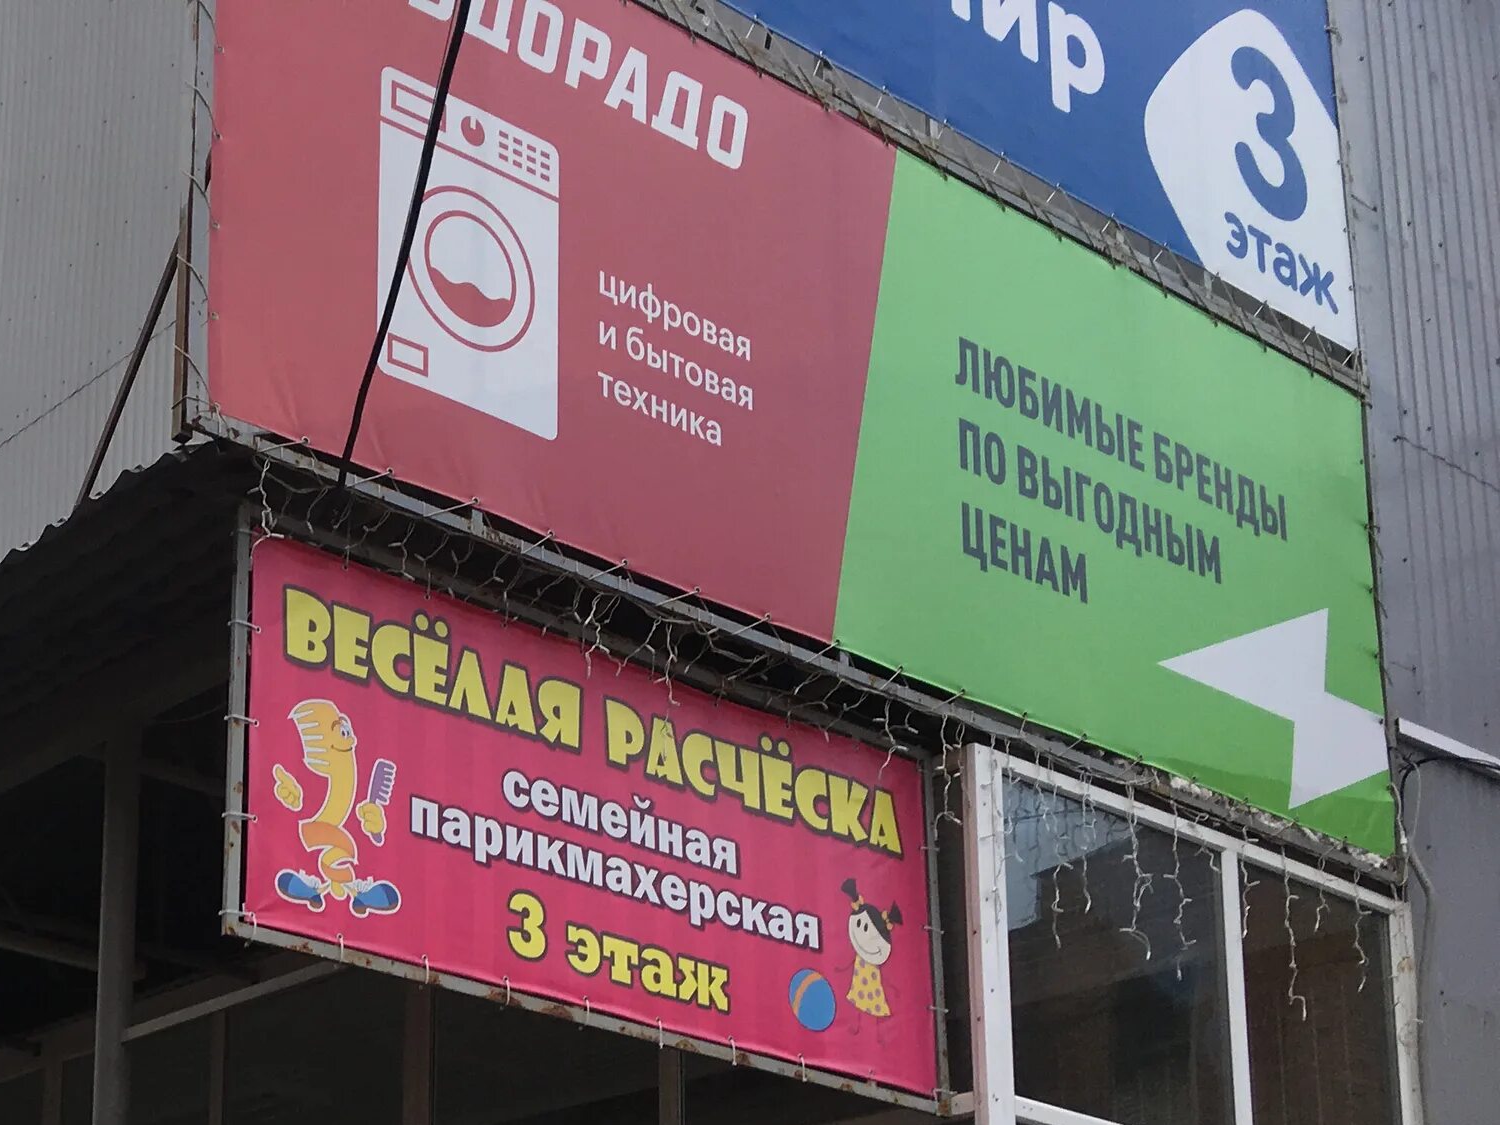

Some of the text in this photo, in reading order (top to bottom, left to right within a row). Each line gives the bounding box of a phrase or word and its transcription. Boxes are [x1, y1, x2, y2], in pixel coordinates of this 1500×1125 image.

[951, 0, 1106, 113] ир
[1230, 46, 1308, 221] 3
[599, 270, 751, 361] цифровая
[1225, 212, 1339, 314] этаж
[597, 371, 722, 447] техника
[599, 320, 754, 410] и бытовая
[955, 337, 1288, 541] ЛЮБИМЫЕ БРЕНДЫ
[957, 417, 1222, 584] ПО ВЫГОДНЫМ
[960, 502, 1088, 604] ЦЕНАМ
[283, 585, 903, 857] ВЕСЁЛАЯ РАСЧЁСКА
[410, 797, 820, 950] парикмахерская
[501, 770, 738, 875] семейная
[507, 890, 730, 1013] 3 этаж
